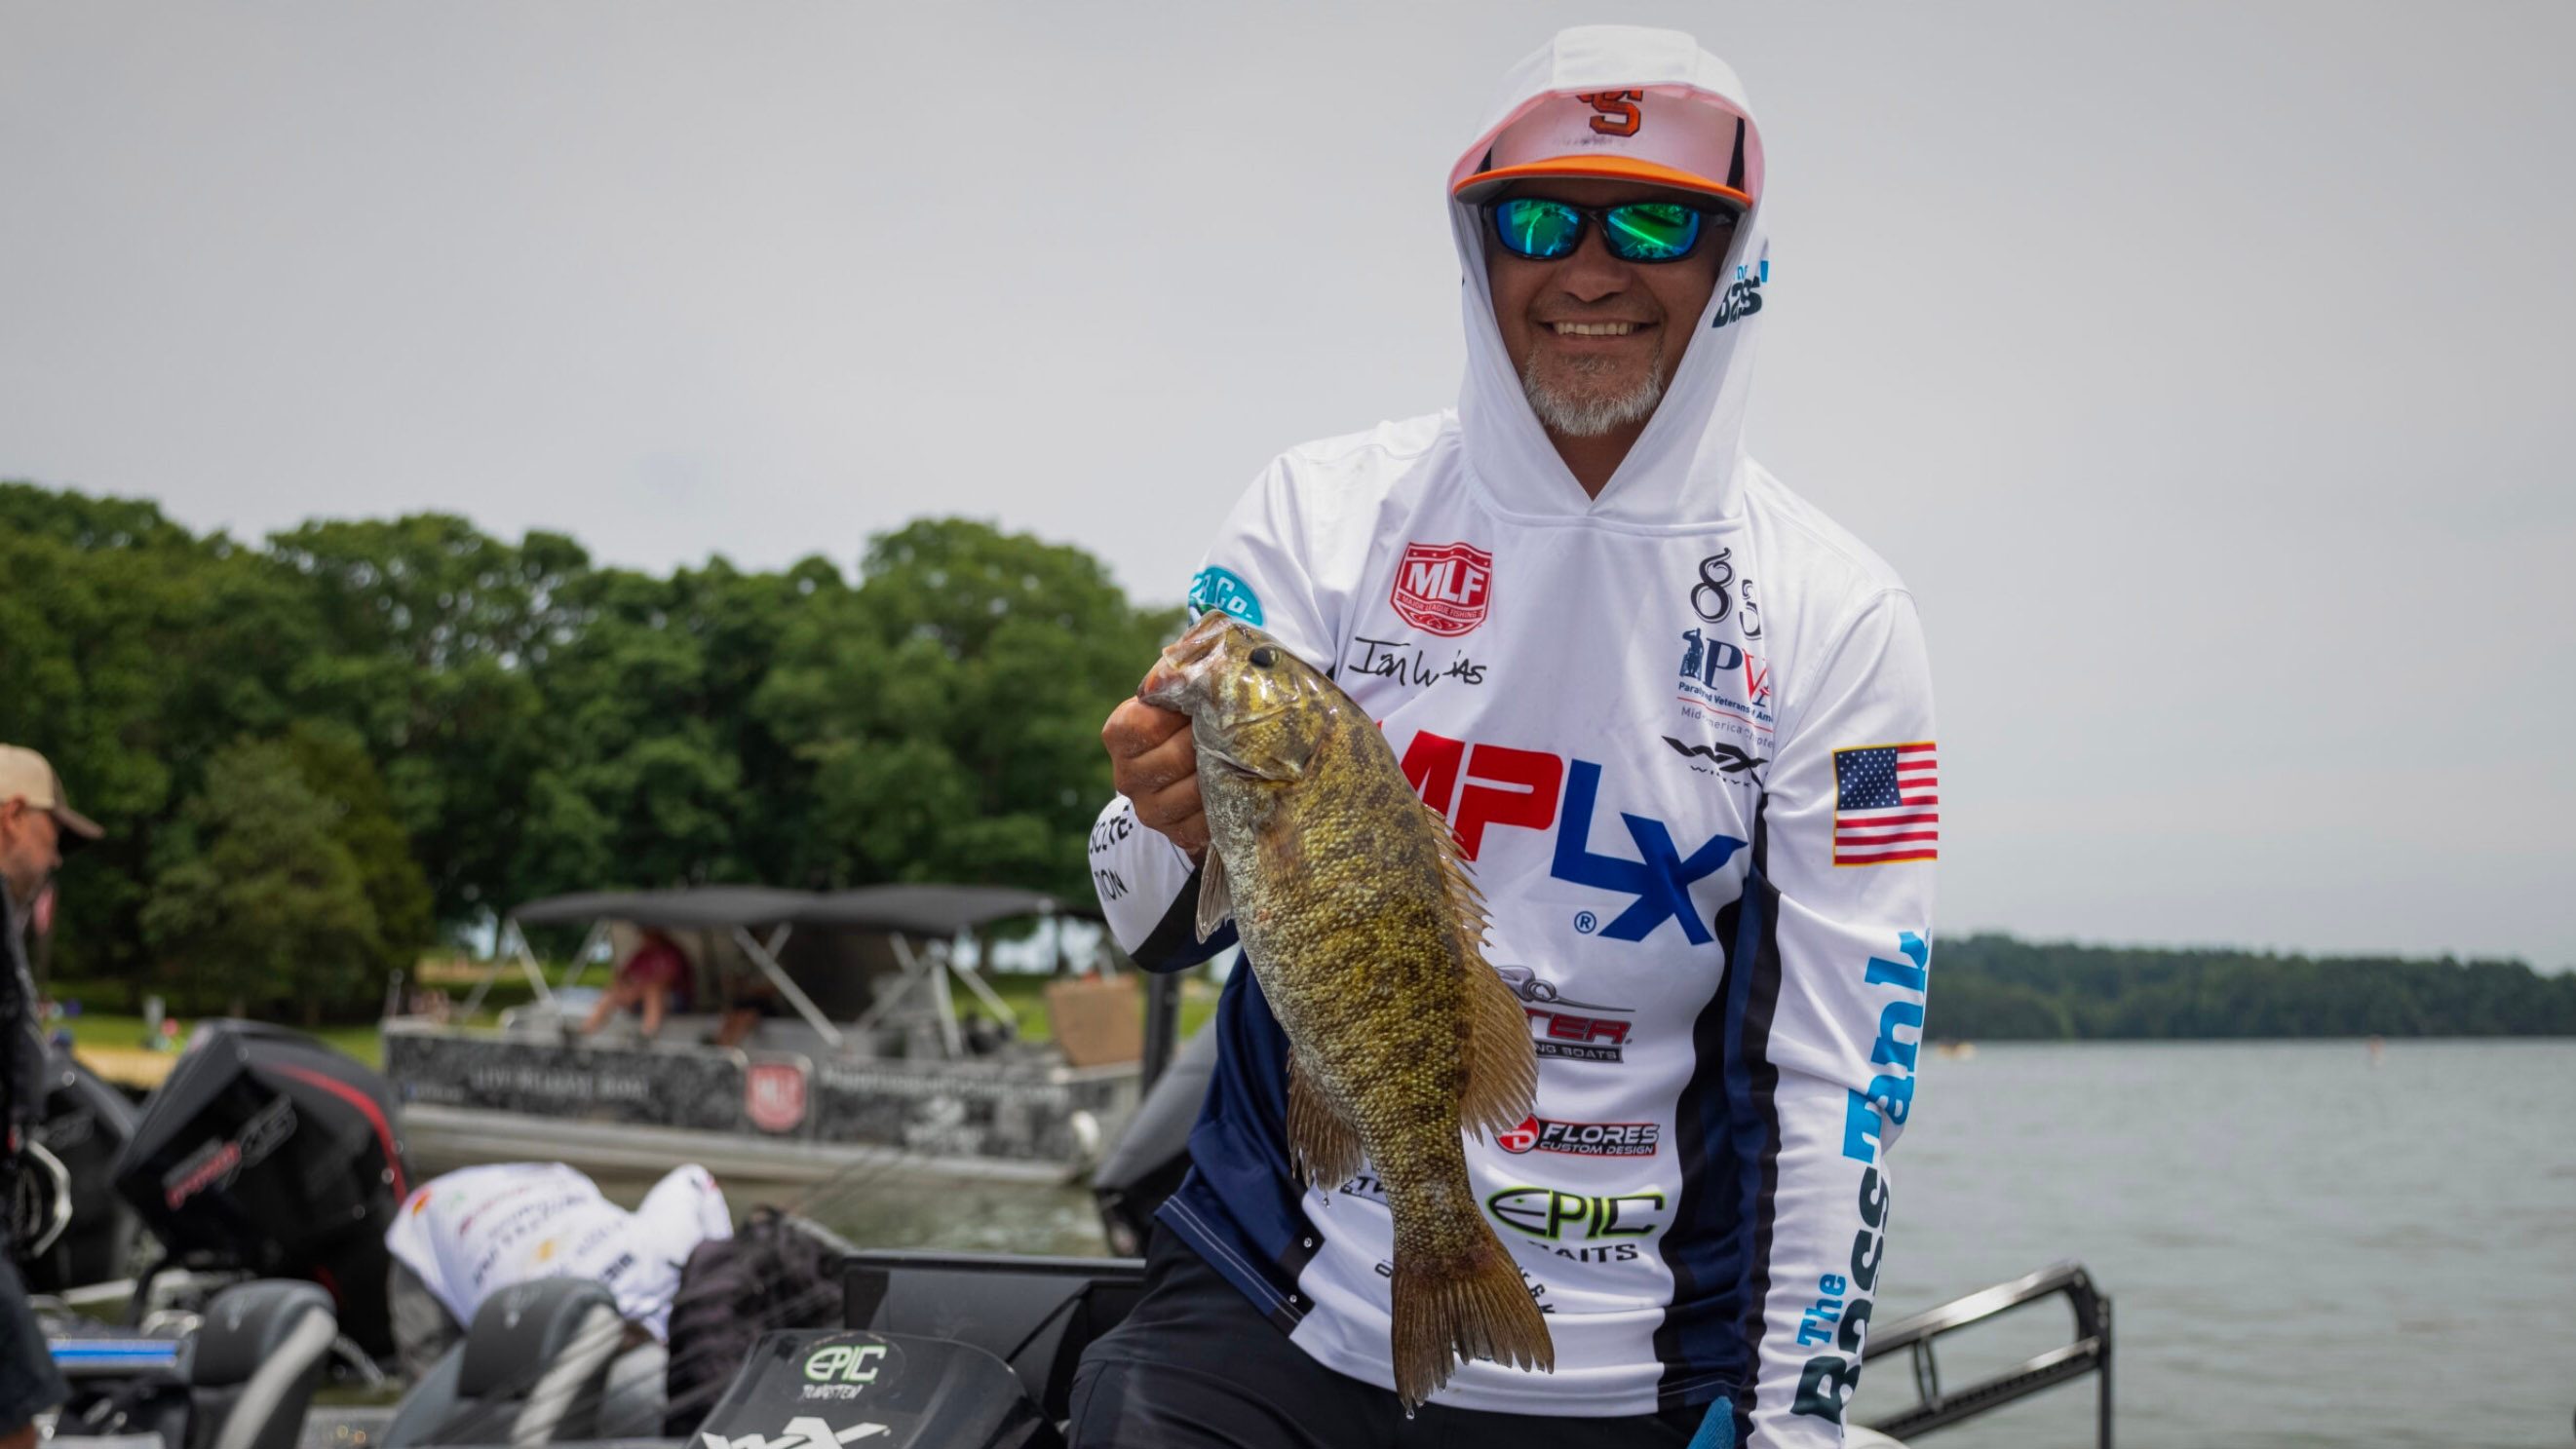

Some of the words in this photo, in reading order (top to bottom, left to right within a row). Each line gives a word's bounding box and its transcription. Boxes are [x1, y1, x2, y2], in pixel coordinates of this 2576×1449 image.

[1405, 560, 1484, 604] MLF
[1402, 595, 1425, 612] MAJOR
[1425, 603, 1449, 616] LEAGUE
[1449, 608, 1478, 619] FISHING
[1714, 695, 1750, 713] Veterans
[1523, 1007, 1632, 1046] TER
[1540, 1140, 1603, 1154] CUSTOM
[1605, 1142, 1655, 1156] DESIGN
[1543, 1123, 1661, 1145] FLORES
[1485, 1185, 1666, 1241] EPIC
[1527, 1239, 1639, 1264] AITS
[1796, 1274, 1848, 1348] The
[804, 1344, 888, 1384] EPIC
